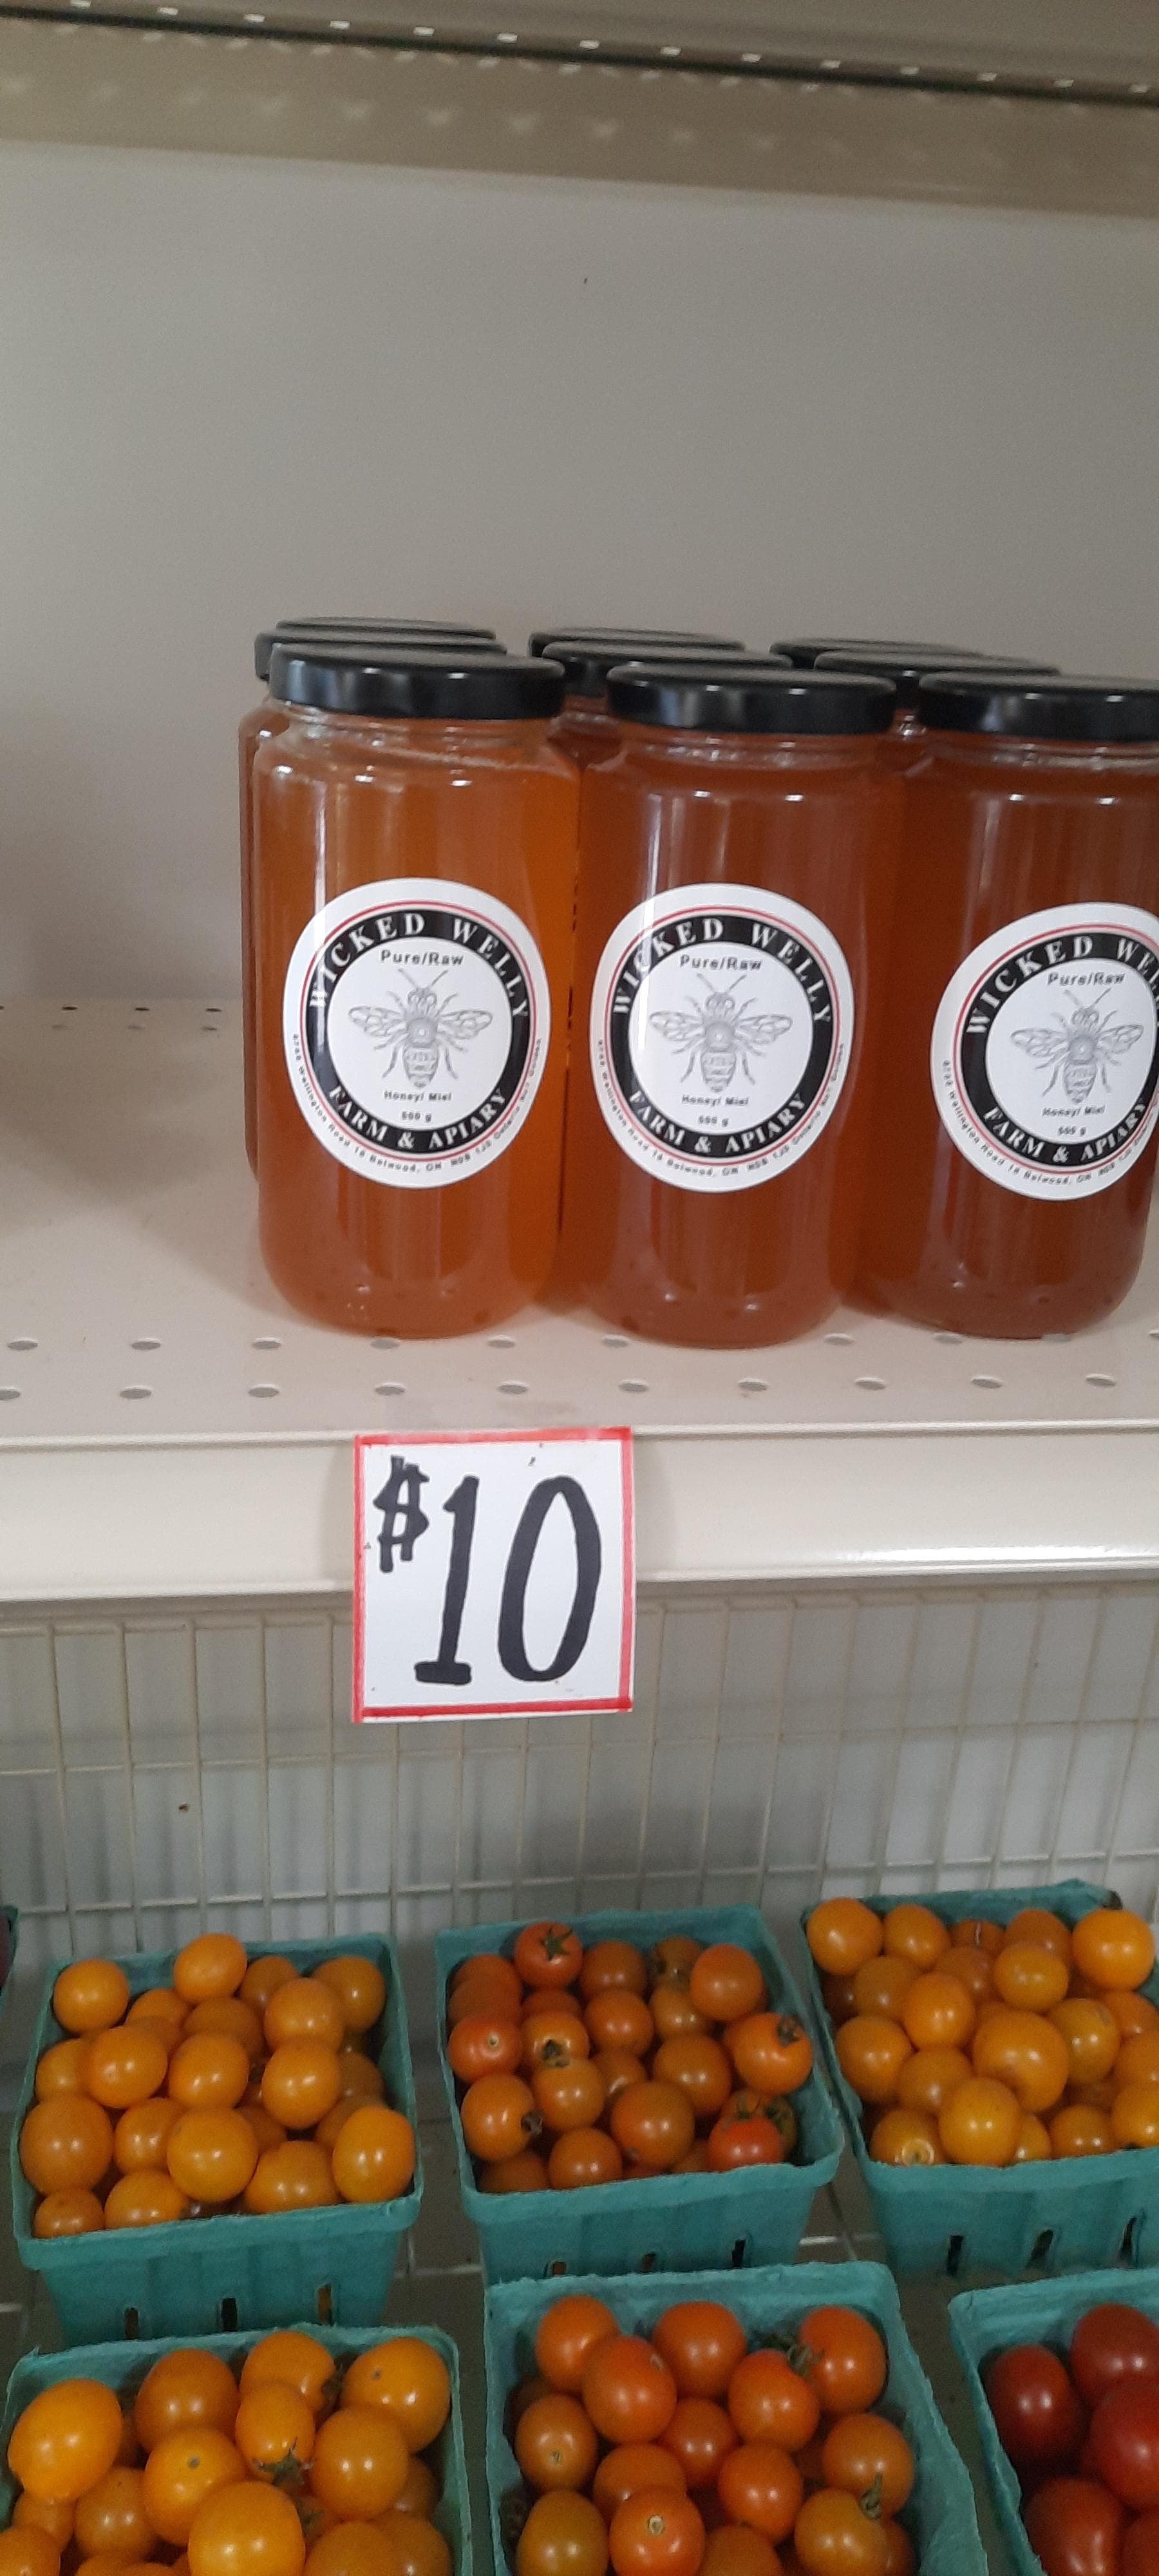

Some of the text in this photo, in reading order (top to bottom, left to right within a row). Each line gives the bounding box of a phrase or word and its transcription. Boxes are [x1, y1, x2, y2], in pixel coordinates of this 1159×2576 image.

[309, 913, 529, 1018] WICKED WELLY
[380, 950, 464, 965] Pure/Raw
[613, 918, 831, 1024] WICKED WELLY
[680, 954, 762, 971] Pure/Raw
[966, 936, 1159, 1034] WICKED WEL
[1048, 972, 1126, 986] Pure/Raw
[329, 1086, 505, 1149] FARM & APIARY
[426, 1113, 432, 1122] g
[630, 1090, 686, 1146] FARM
[695, 1136, 711, 1153] &
[725, 1093, 805, 1153] APIARY
[722, 1118, 728, 1127] g
[983, 1106, 1044, 1158] FARM
[1053, 1146, 1070, 1163] &
[1080, 1097, 1146, 1161] APIARY
[372, 1454, 603, 1686] $10
